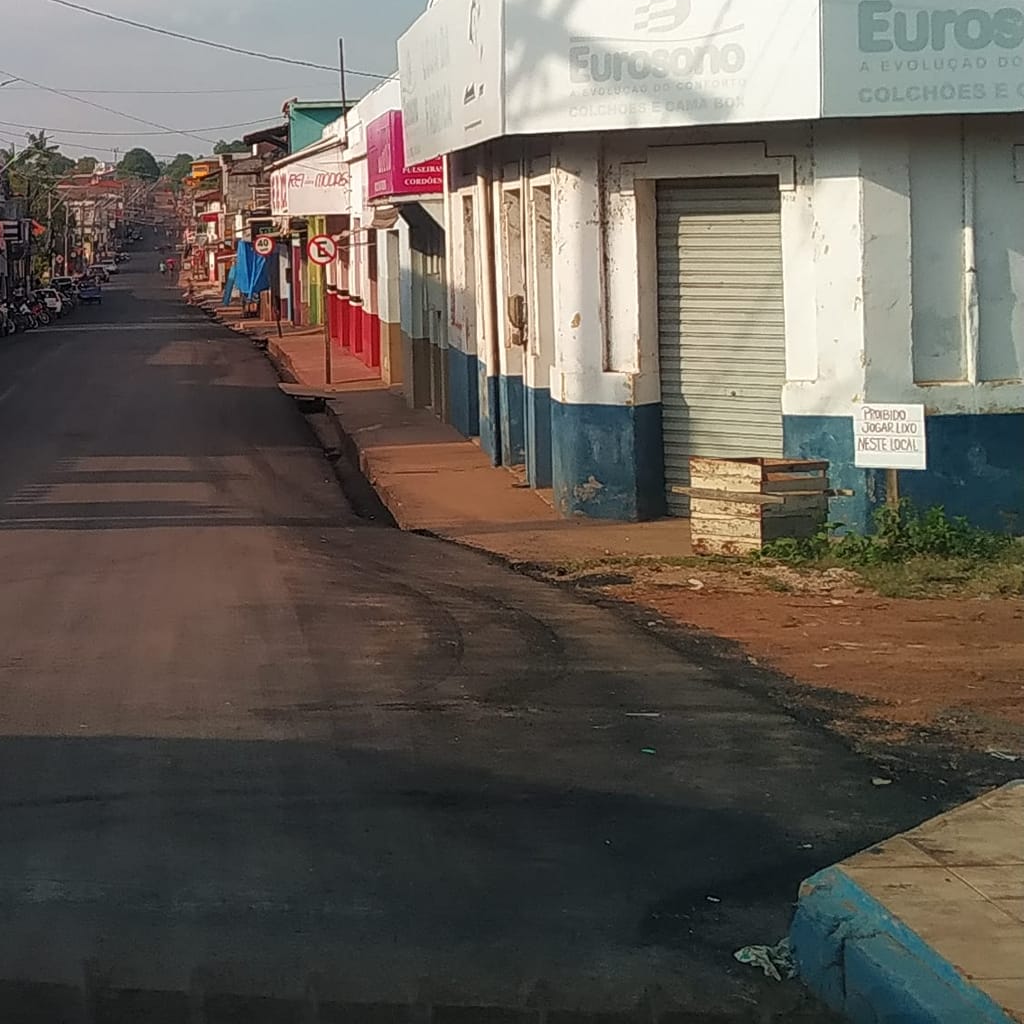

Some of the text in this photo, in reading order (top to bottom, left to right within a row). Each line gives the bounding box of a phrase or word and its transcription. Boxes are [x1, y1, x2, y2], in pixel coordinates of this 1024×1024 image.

[568, 43, 746, 84] Eurosono
[860, 60, 869, 72] A
[998, 56, 1022, 68] DO
[994, 82, 1008, 99] E
[258, 239, 269, 247] 40
[861, 406, 907, 421] PROIBIDO
[861, 422, 917, 434] JOGAR LIXO
[857, 437, 918, 452] NESTE LOCAL
